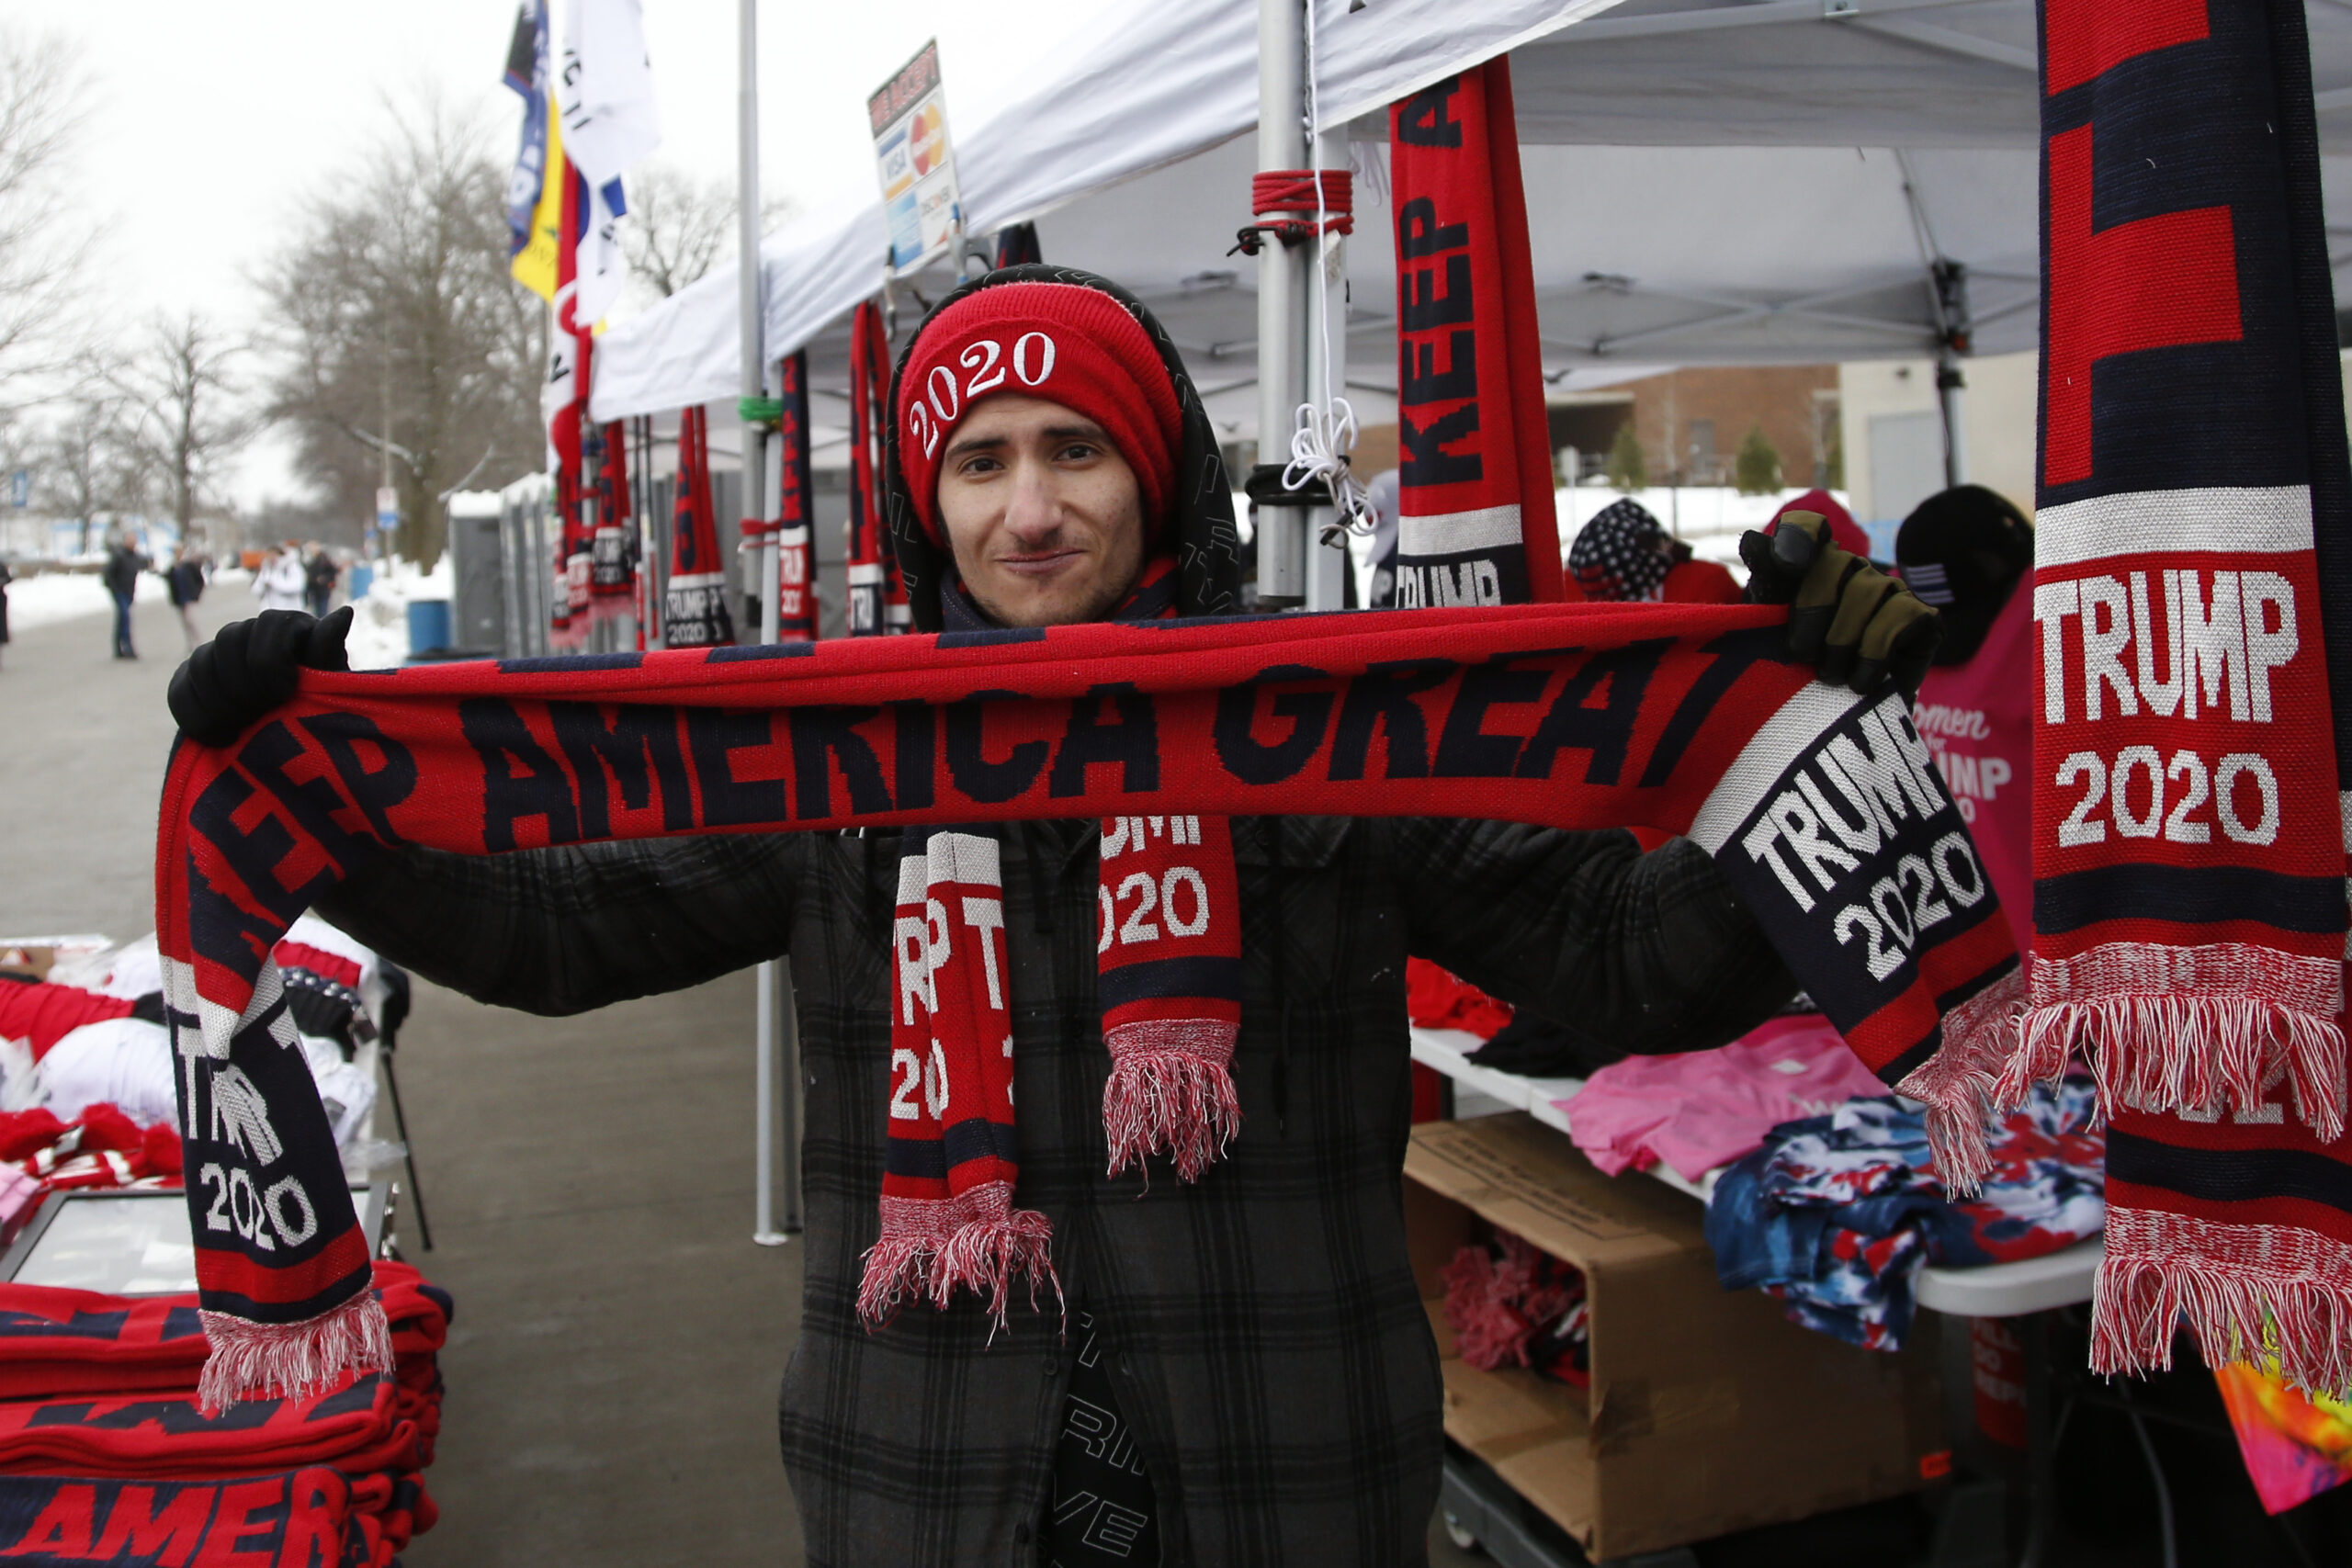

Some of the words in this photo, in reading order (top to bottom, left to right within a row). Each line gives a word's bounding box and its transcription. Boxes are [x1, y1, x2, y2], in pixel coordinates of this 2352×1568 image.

[887, 147, 907, 181] VISA
[909, 331, 1057, 460] 2020
[1400, 196, 1484, 488] KEEP
[667, 622, 707, 645] 2020
[2033, 569, 2300, 725] TRUMP
[458, 681, 1163, 854] AMERICA
[1211, 623, 1791, 789] GREAT
[1912, 702, 1992, 741] omen
[1742, 692, 1948, 914] TRUMP
[2054, 744, 2280, 849] 2020
[1833, 830, 1985, 983] 2020
[198, 1161, 318, 1248] 2020
